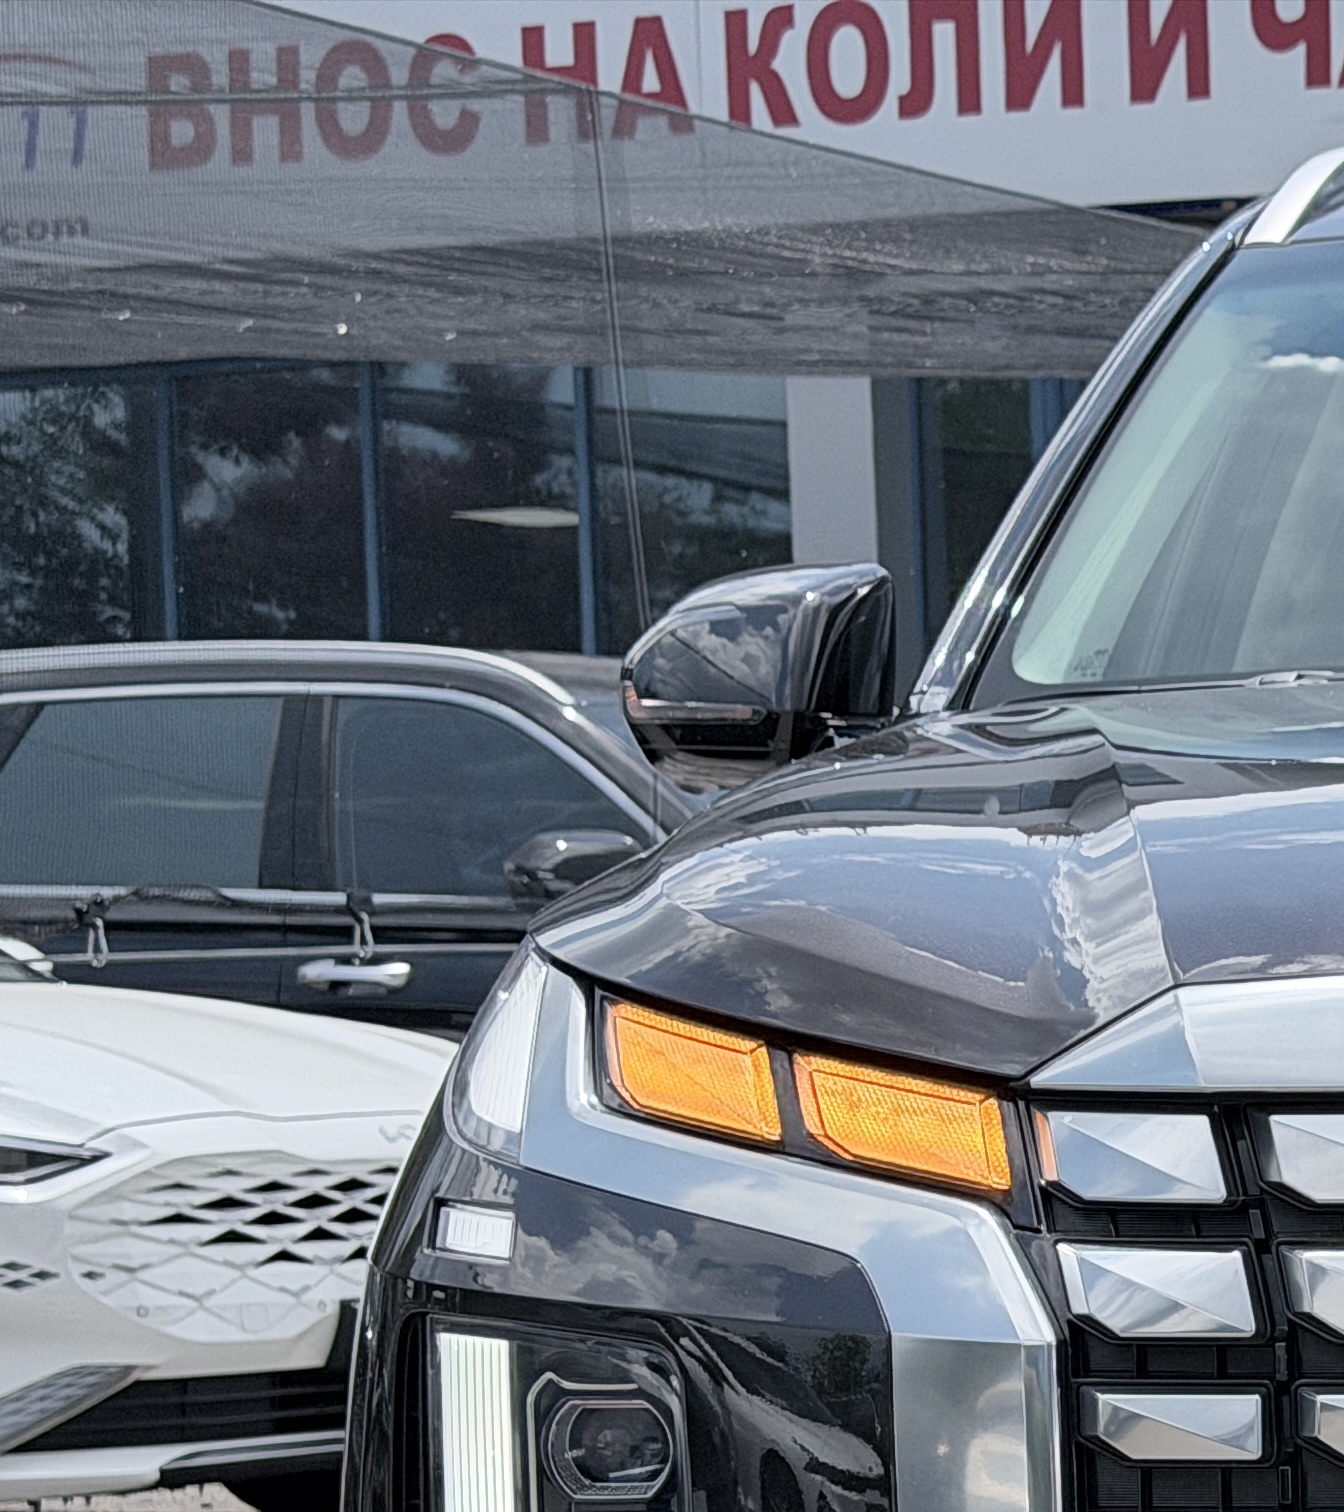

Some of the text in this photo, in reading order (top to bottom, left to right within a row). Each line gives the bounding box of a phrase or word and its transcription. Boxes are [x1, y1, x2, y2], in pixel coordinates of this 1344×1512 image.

[147, 32, 482, 171] ВНОС
[521, 16, 695, 145] НА
[724, 0, 1085, 128] КОЛИ
[1127, 0, 1211, 106] И
